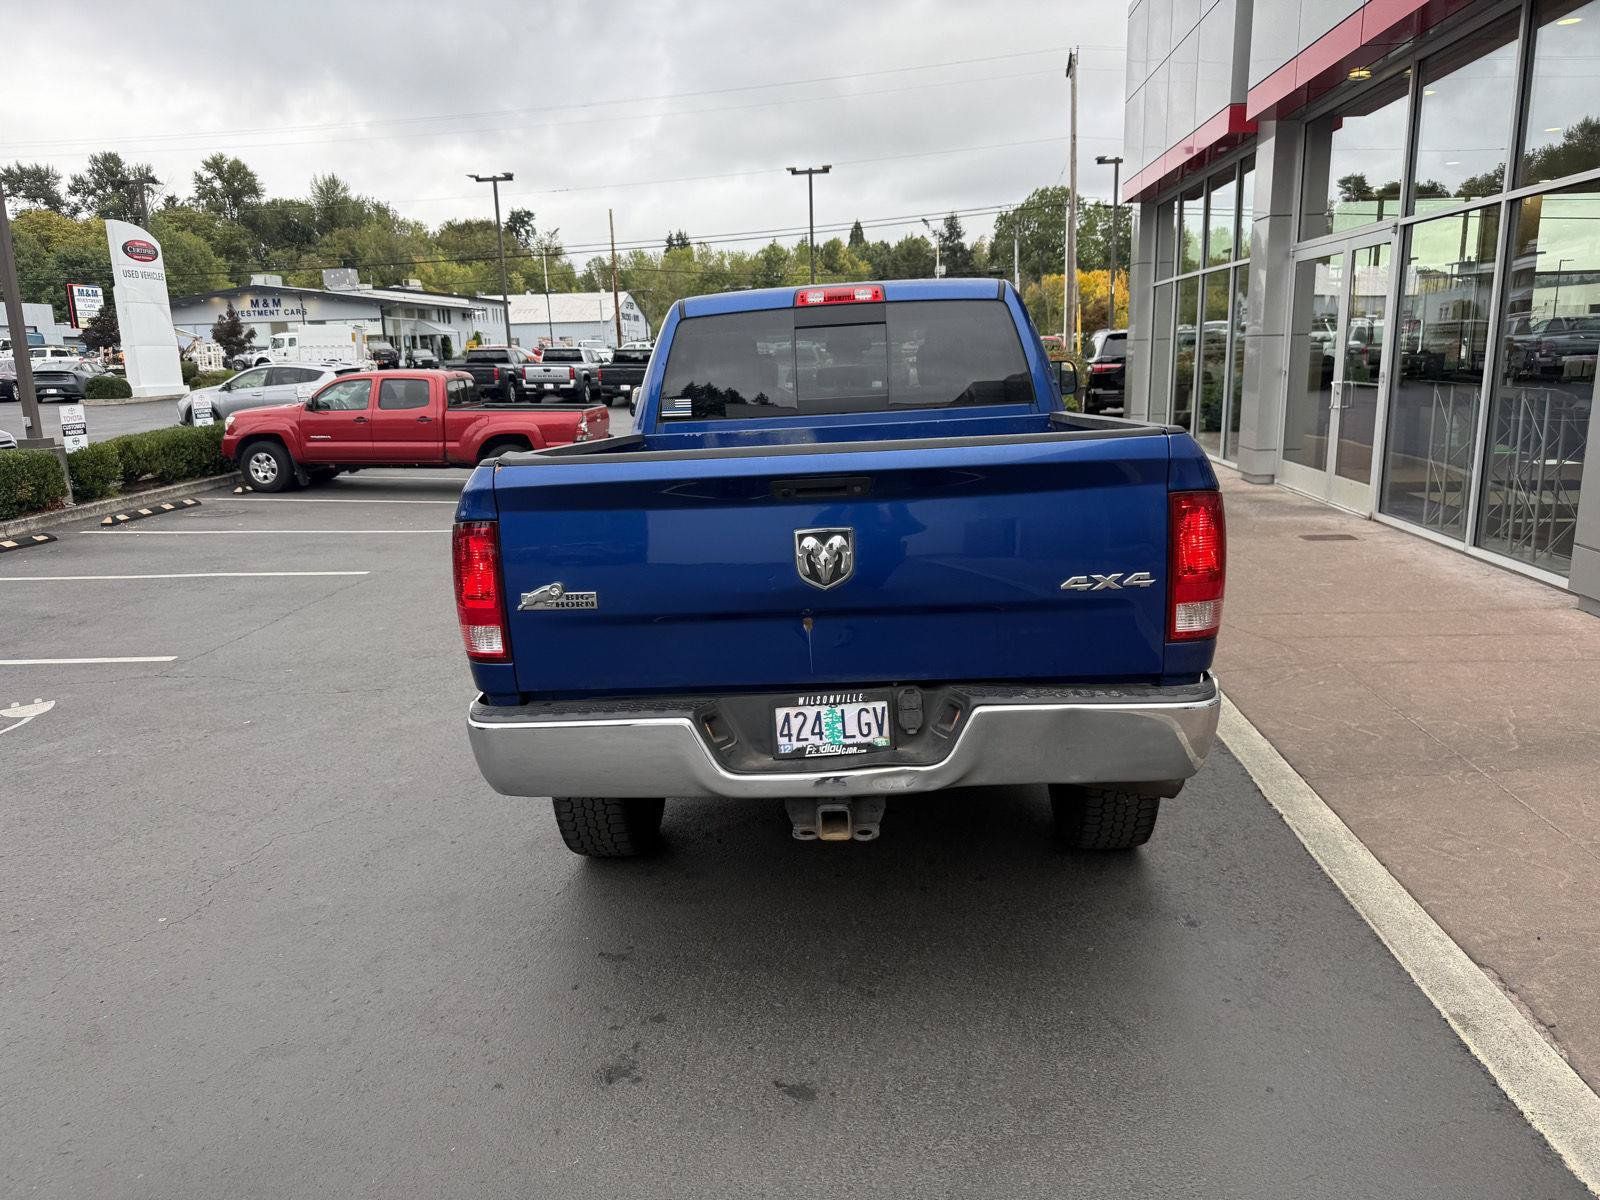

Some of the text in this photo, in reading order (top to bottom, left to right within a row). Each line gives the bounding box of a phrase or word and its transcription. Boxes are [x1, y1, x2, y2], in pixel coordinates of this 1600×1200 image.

[122, 270, 164, 281] USED VEHICLES
[77, 288, 98, 298] M&M
[250, 299, 260, 309] M
[272, 299, 281, 308] M
[284, 308, 307, 316] CARS
[798, 693, 863, 705] WILSONVILLE
[779, 706, 886, 743] 424 LGV
[780, 745, 791, 753] 12
